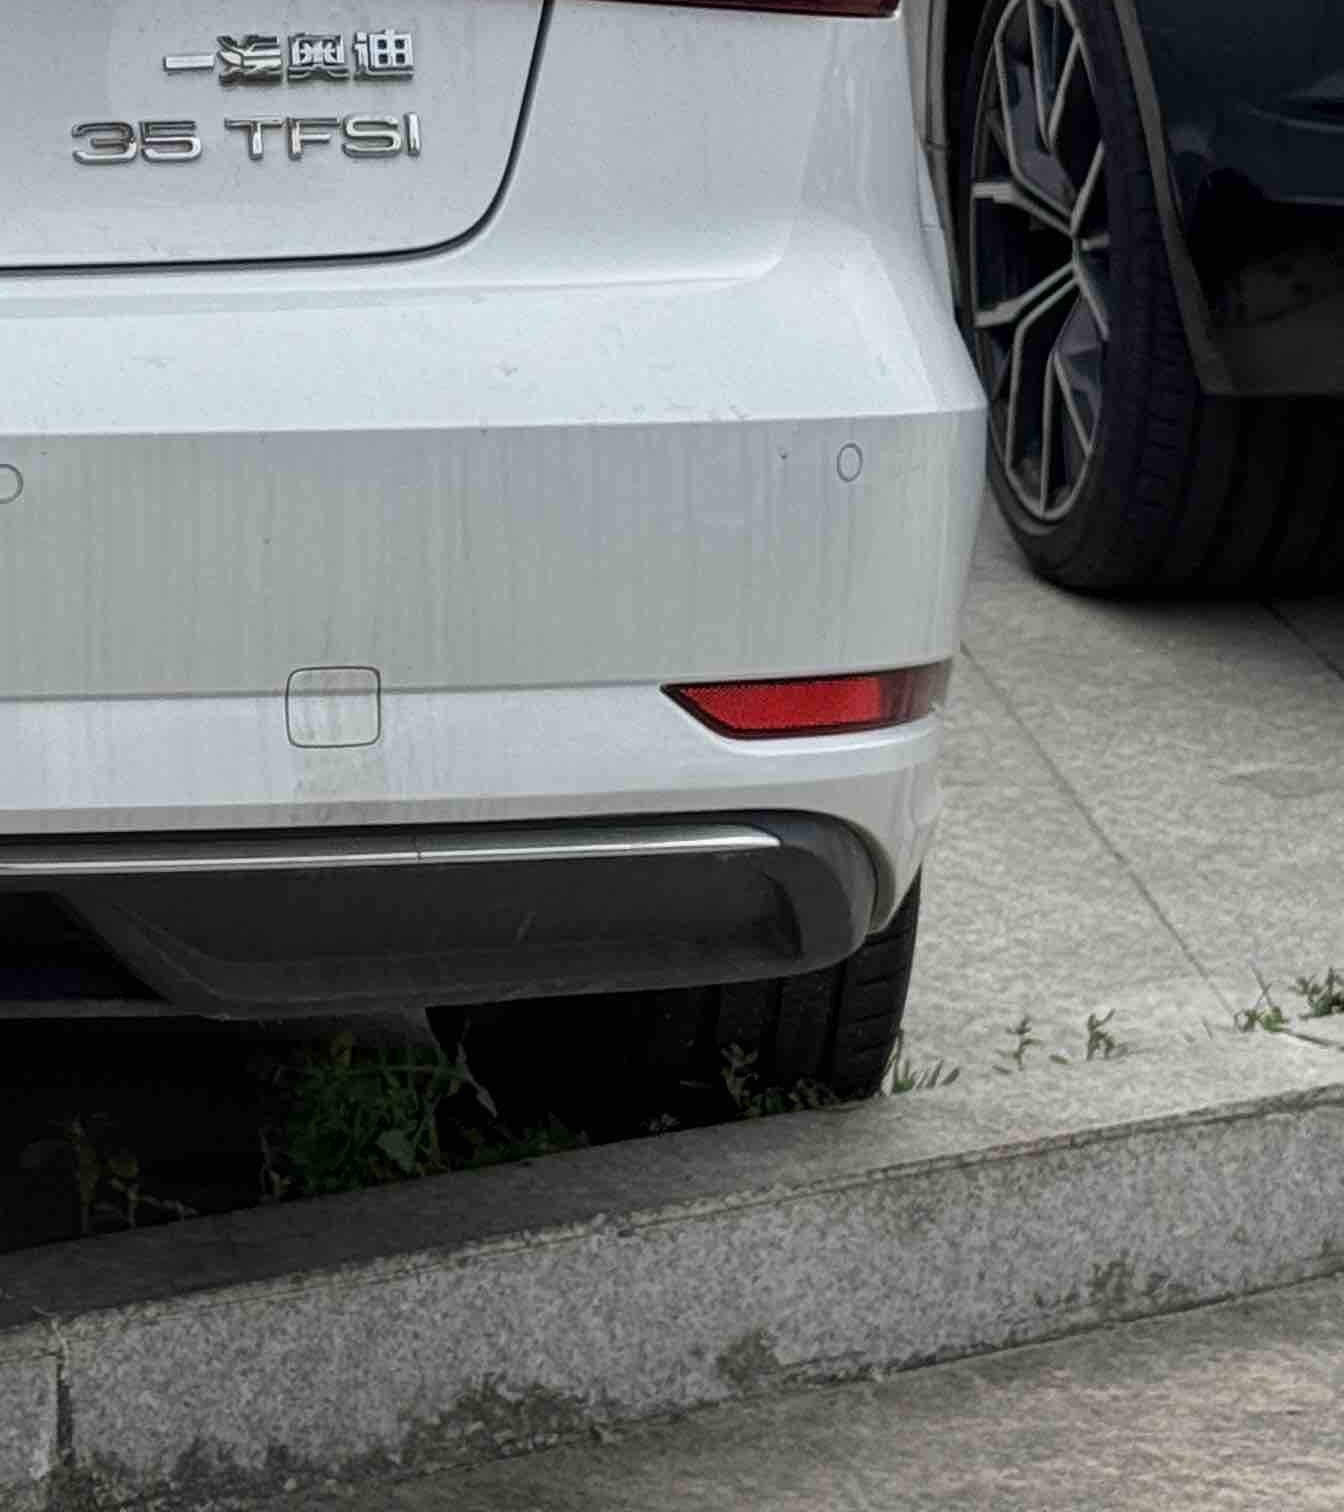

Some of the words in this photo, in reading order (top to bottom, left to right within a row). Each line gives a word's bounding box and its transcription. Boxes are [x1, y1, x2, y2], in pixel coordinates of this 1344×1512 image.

[163, 29, 415, 86] 一汽奥迪
[71, 119, 203, 165] 35
[224, 111, 422, 162] TFSI
